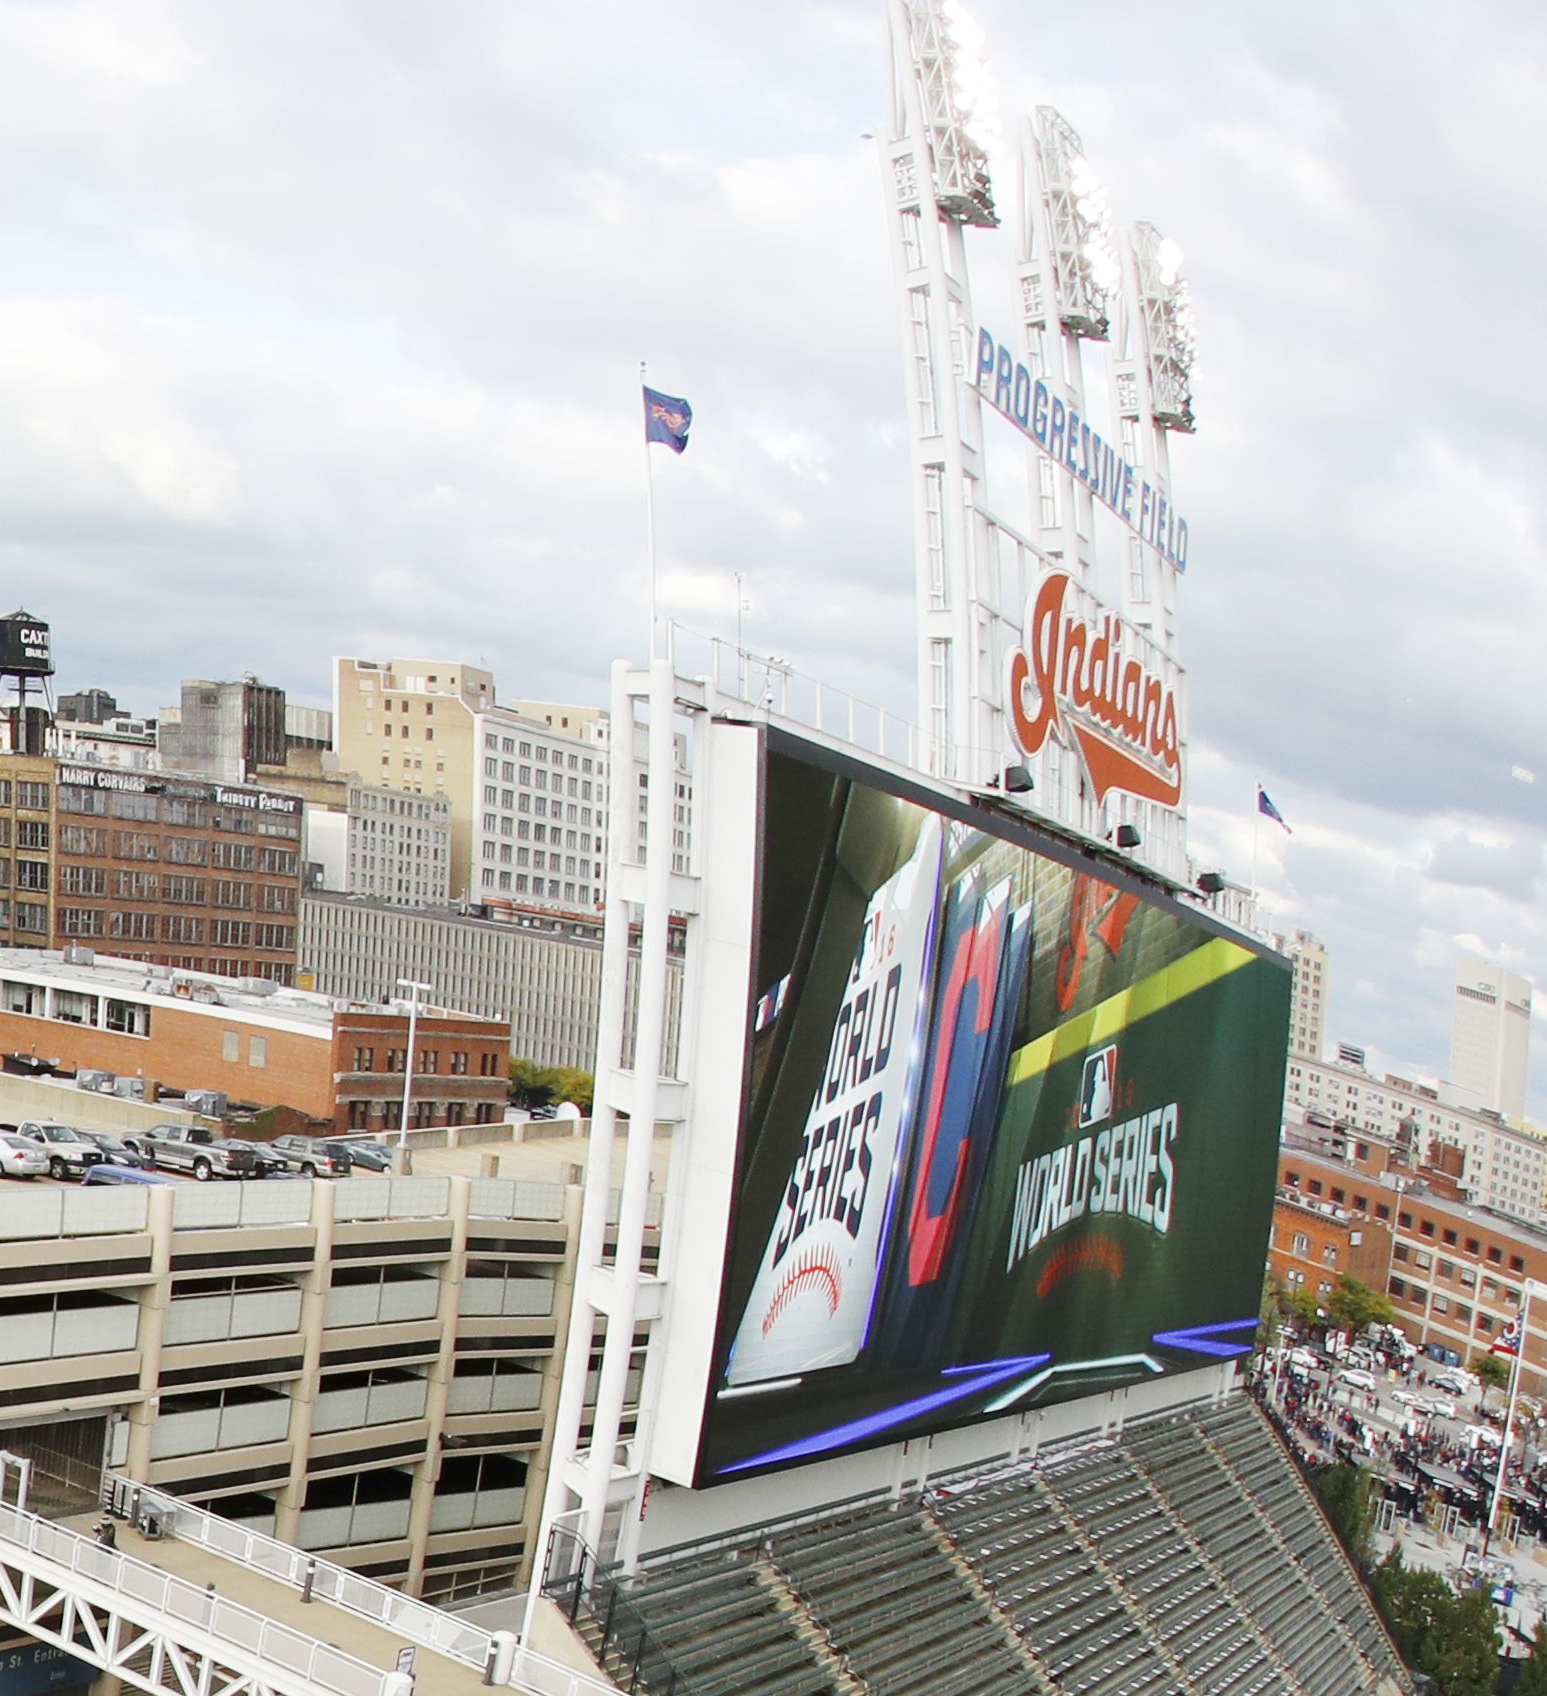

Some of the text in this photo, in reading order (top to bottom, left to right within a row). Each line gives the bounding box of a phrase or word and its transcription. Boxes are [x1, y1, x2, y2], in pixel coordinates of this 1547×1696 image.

[975, 326, 1188, 572] PROGRESSIVE FIELD
[1009, 572, 1182, 772] Indians
[61, 766, 95, 786] HARRY
[96, 772, 146, 793] CORVAIRS
[814, 963, 903, 1111] ORLD
[772, 1091, 883, 1270] SERIES
[1006, 1102, 1178, 1274] WORLD SERIES
